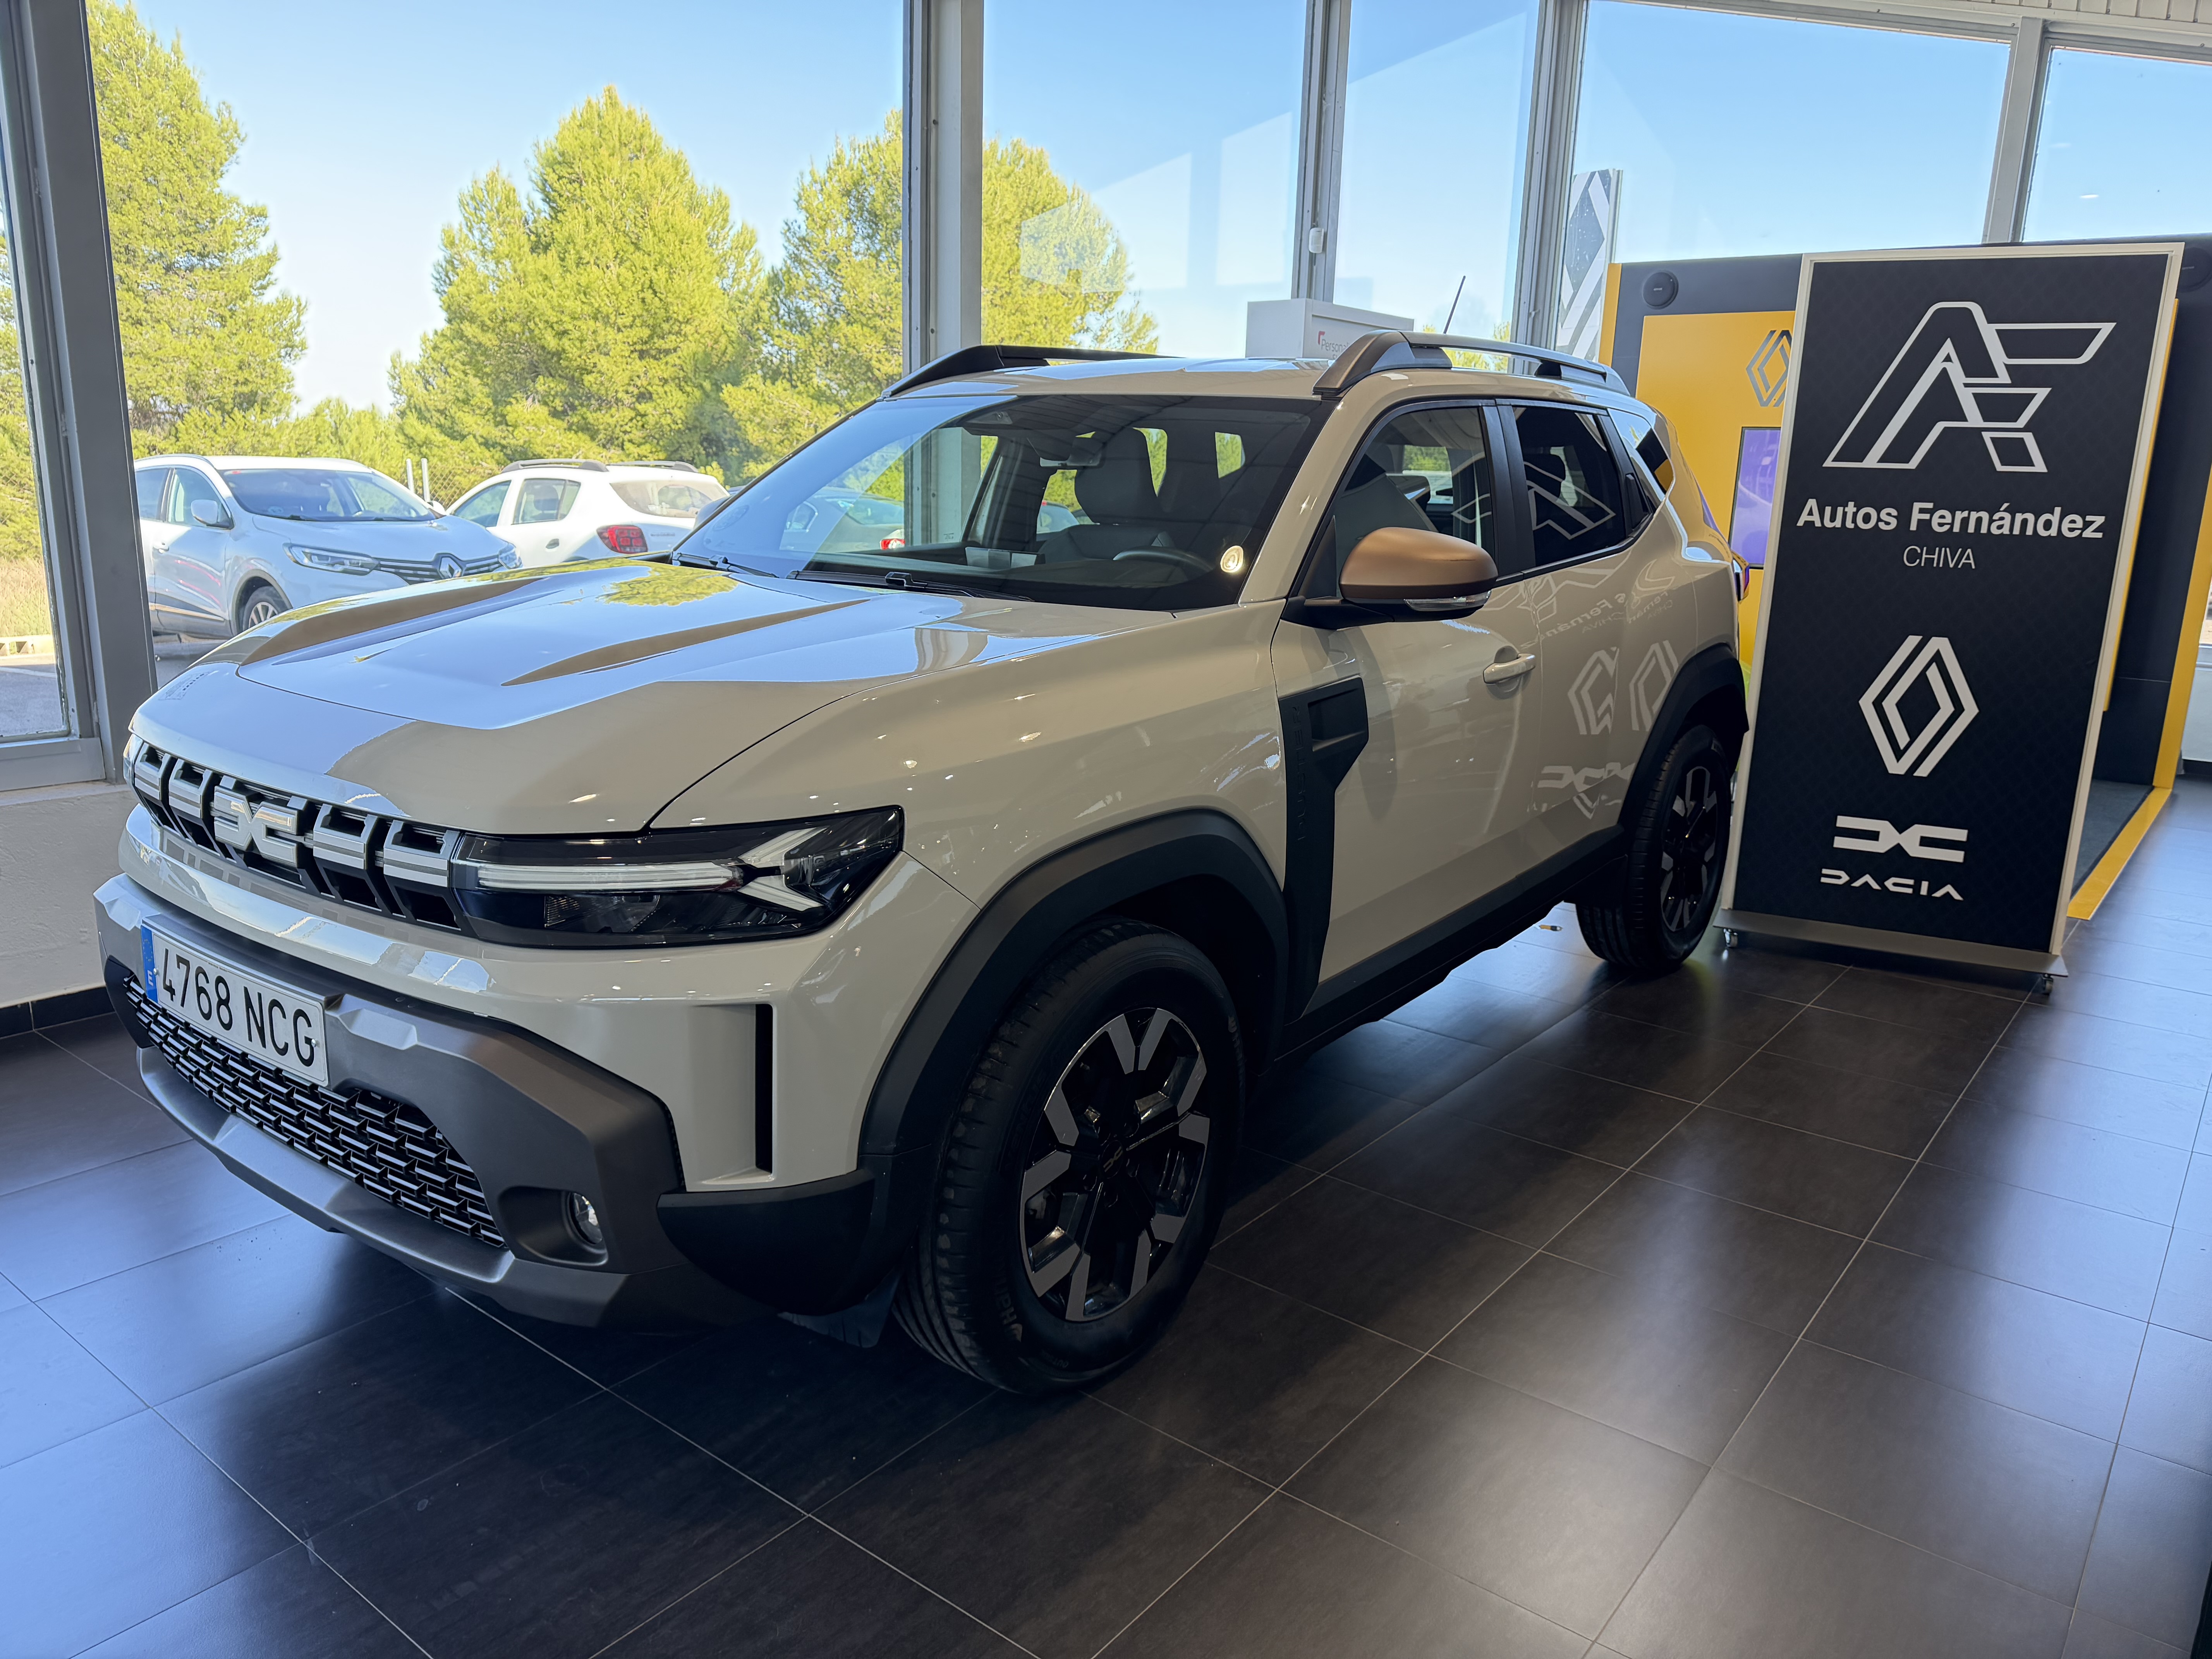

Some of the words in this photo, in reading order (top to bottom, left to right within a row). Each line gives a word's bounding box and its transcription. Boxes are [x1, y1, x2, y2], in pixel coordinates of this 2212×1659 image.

[1796, 498, 1898, 530] Autos
[1910, 502, 2106, 538] Fernández
[1903, 546, 1975, 569] CHIVA
[1820, 868, 1963, 900] DACIA
[147, 969, 154, 986] E
[163, 948, 233, 1031] 4768
[244, 986, 315, 1067] NCG
